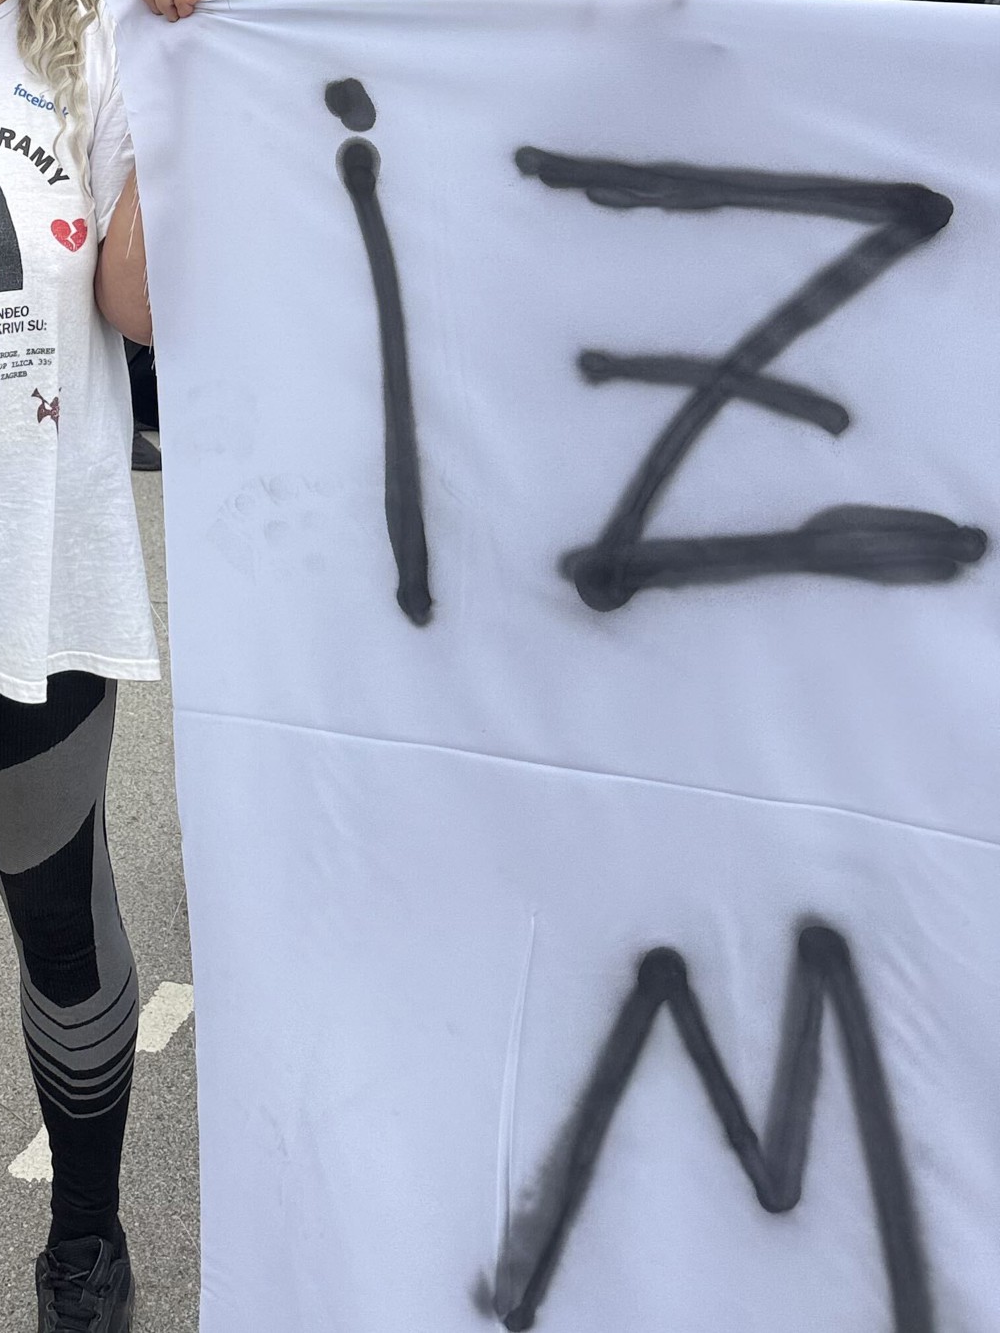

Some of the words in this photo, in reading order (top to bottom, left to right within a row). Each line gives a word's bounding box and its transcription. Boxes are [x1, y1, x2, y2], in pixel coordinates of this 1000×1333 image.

[13, 83, 70, 119] facebok
[27, 319, 48, 332] SU:
[0, 370, 28, 381] ZAGREB
